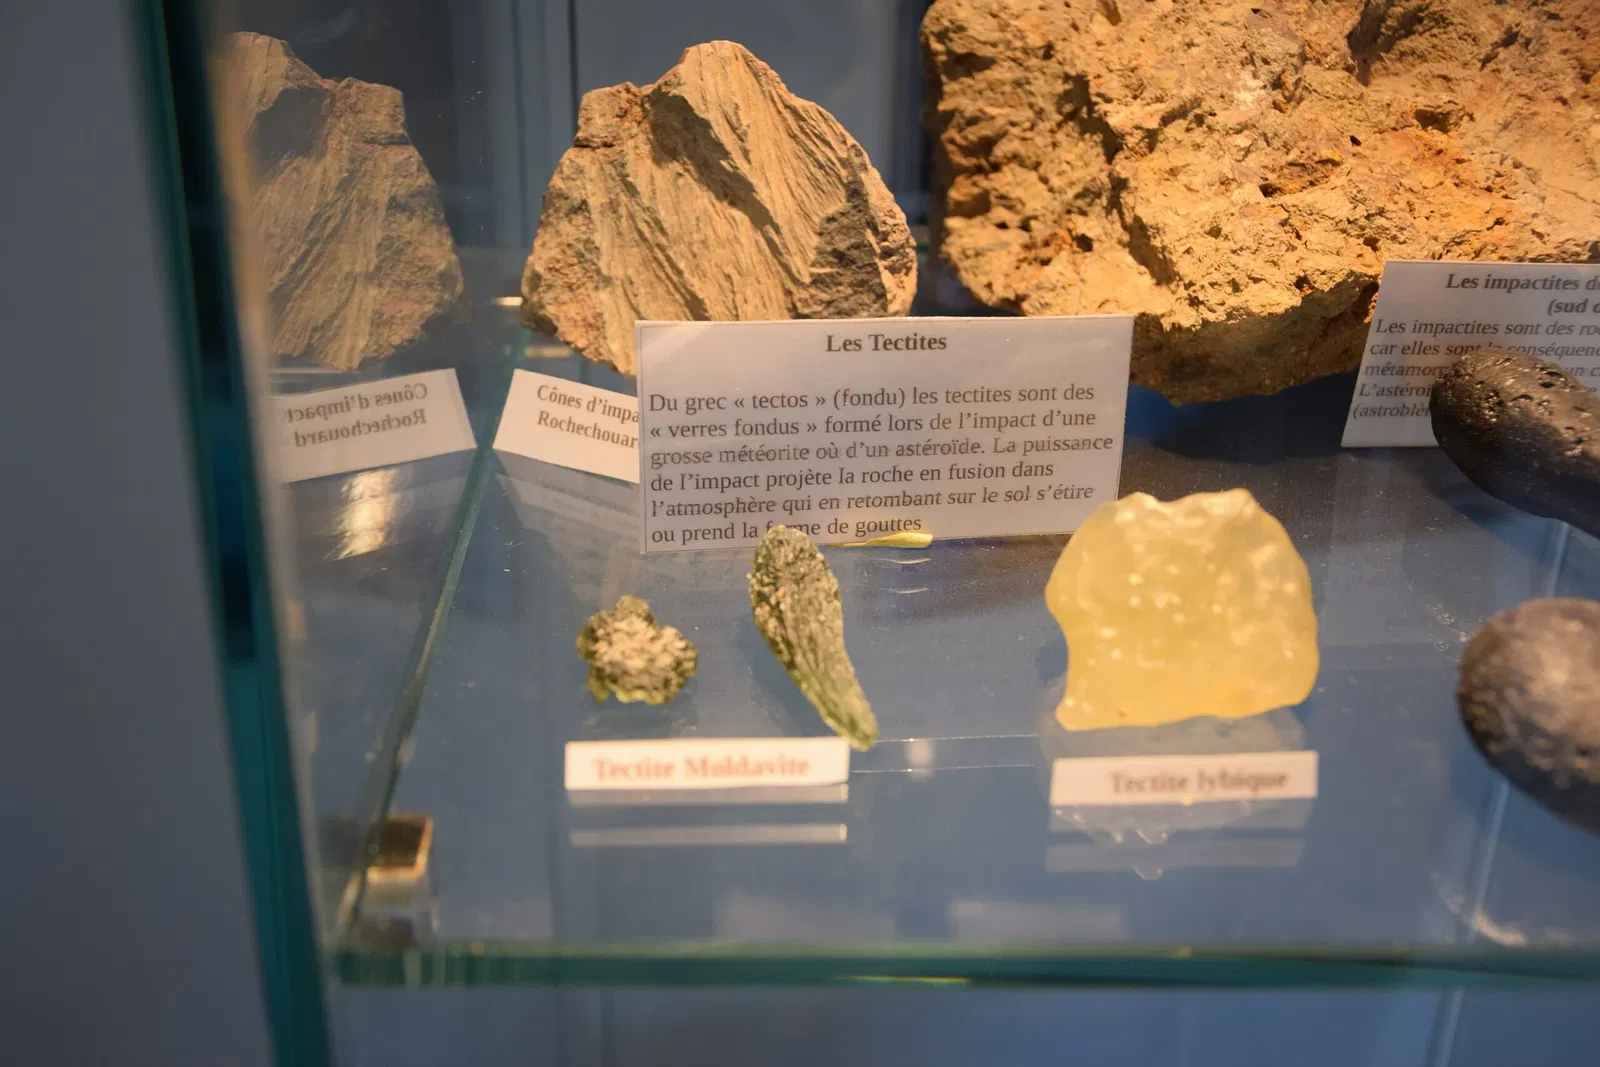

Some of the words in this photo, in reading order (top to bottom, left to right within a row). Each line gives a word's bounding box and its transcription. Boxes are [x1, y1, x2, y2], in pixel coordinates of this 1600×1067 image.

[1446, 274, 1479, 289] Les
[1484, 274, 1579, 293] impactites
[1548, 298, 1589, 316] (sud
[826, 334, 862, 352] Les
[868, 332, 947, 352] Tectites
[1375, 319, 1406, 334] Les
[1412, 320, 1499, 339] impactites
[1504, 322, 1542, 335] sont
[1545, 320, 1574, 336] des
[1370, 343, 1398, 356] car
[1401, 341, 1440, 356] elles
[537, 384, 582, 409] Cônes
[649, 394, 678, 412] Du
[685, 396, 726, 415] grec
[752, 393, 808, 409] tectos
[833, 387, 905, 411] (fondu)
[912, 387, 938, 405] les
[945, 385, 1011, 403] tectites
[1018, 386, 1058, 402] sont
[1063, 383, 1094, 401] des
[537, 410, 639, 449] Rochechouar
[668, 424, 727, 437] verres
[734, 418, 799, 436] fondus
[824, 415, 882, 434] formé
[888, 414, 923, 432] lors
[929, 413, 952, 430] de
[958, 411, 1036, 433] l’impact
[1043, 410, 1096, 428] d’une
[651, 450, 713, 469] grosse
[718, 444, 810, 463] météorite
[816, 441, 839, 460] où
[845, 440, 888, 459] d’un
[896, 438, 985, 457] astéroïde.
[992, 437, 1016, 454] La
[1022, 436, 1113, 457] puissance
[651, 474, 673, 492] de
[680, 473, 760, 493] l’impact
[765, 470, 832, 491] projète
[839, 467, 855, 485] la
[861, 465, 913, 484] roche
[919, 467, 941, 481] en
[948, 462, 1005, 481] fusion
[1012, 461, 1054, 477] dans
[651, 495, 776, 518] l’atmosphère
[782, 494, 811, 515] qui
[819, 496, 840, 510] en
[847, 489, 942, 509] retombant
[947, 491, 976, 505] sur
[981, 487, 998, 504] le
[1004, 485, 1030, 502] sol
[1037, 483, 1094, 501] s’étire
[651, 529, 674, 543] ou
[682, 523, 735, 546] prend
[742, 521, 758, 539] la
[827, 518, 849, 535] de
[855, 517, 922, 538] gouttes
[594, 757, 675, 780] Tectite
[684, 754, 810, 778] Moldavite
[1109, 771, 1189, 793] Tectite
